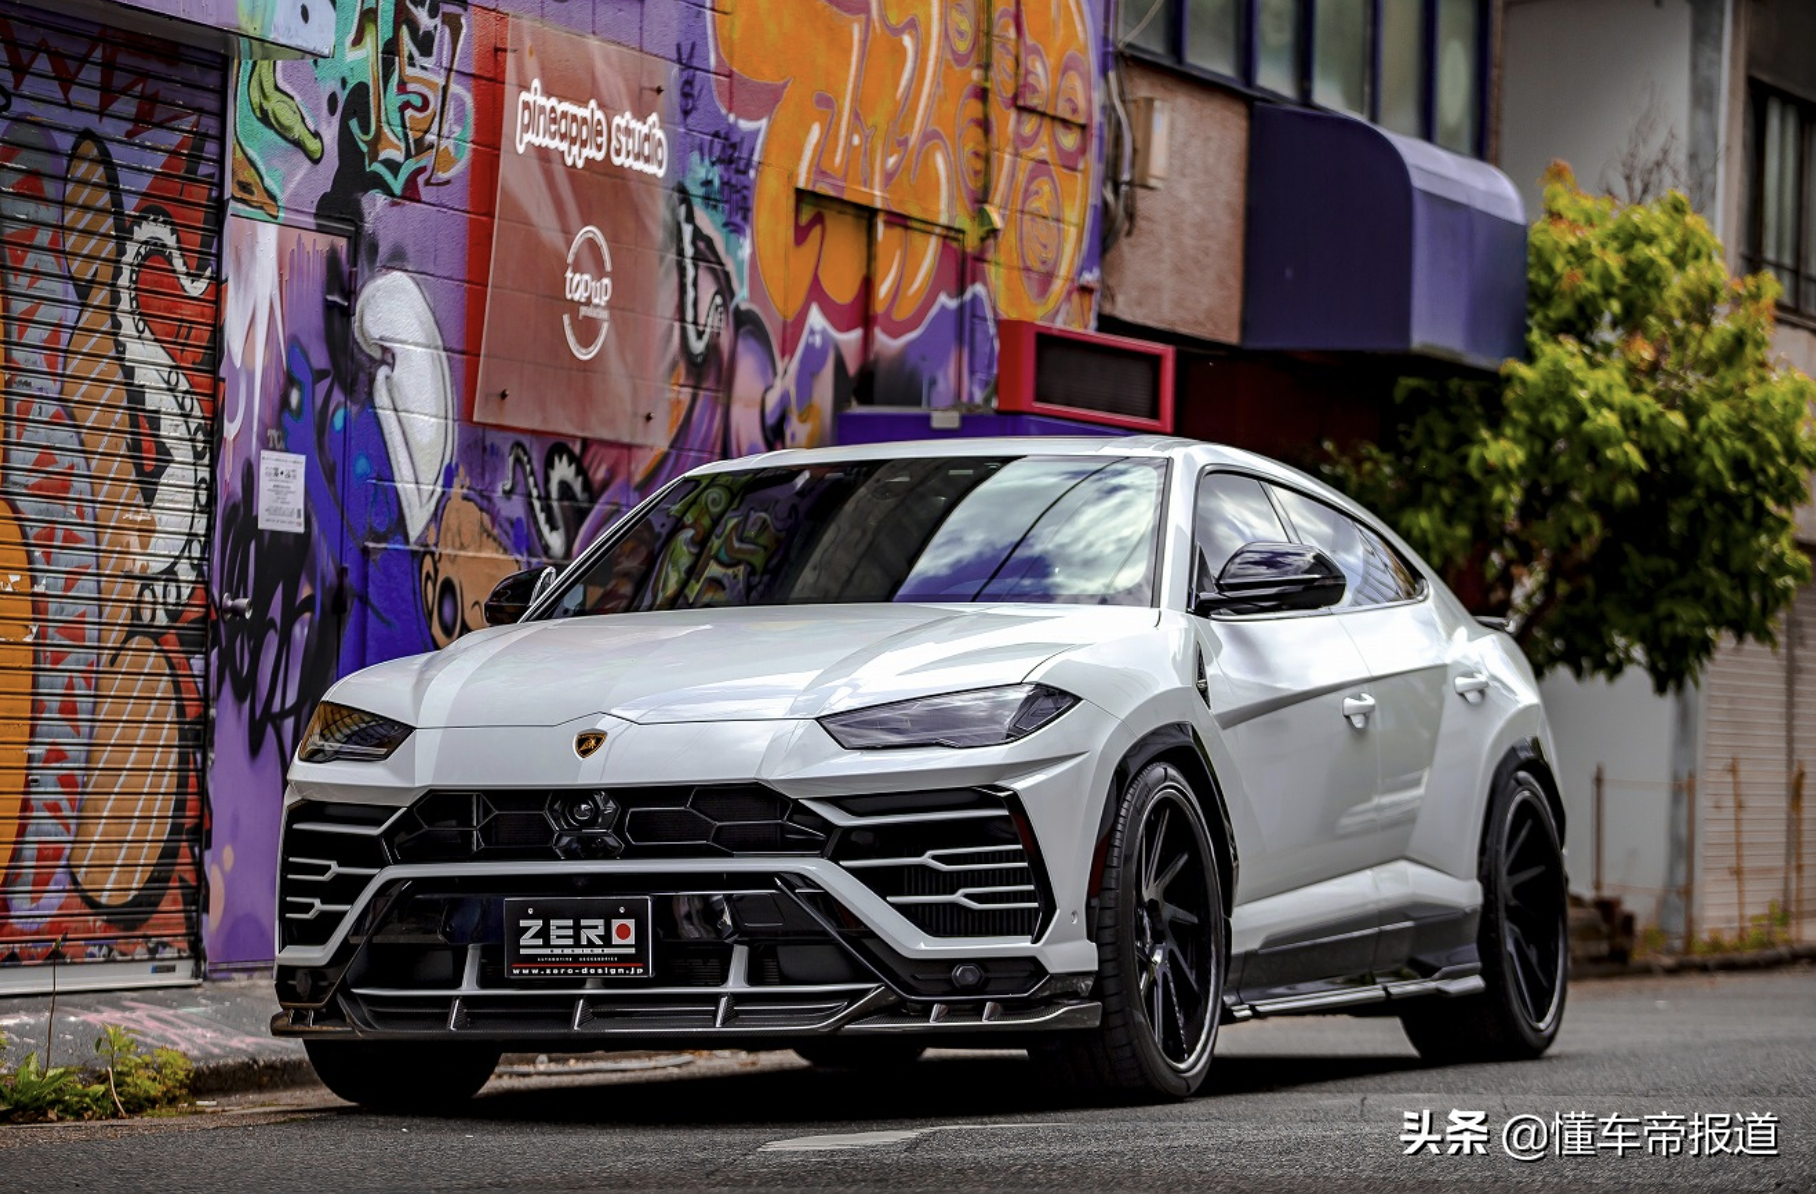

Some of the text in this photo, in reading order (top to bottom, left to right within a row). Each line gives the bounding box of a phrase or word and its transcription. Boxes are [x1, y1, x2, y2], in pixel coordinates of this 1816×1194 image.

[516, 78, 608, 169] pineapple
[610, 111, 669, 178] studio
[519, 919, 636, 946] ZERO
[512, 967, 644, 975] www.zero-design.jp
